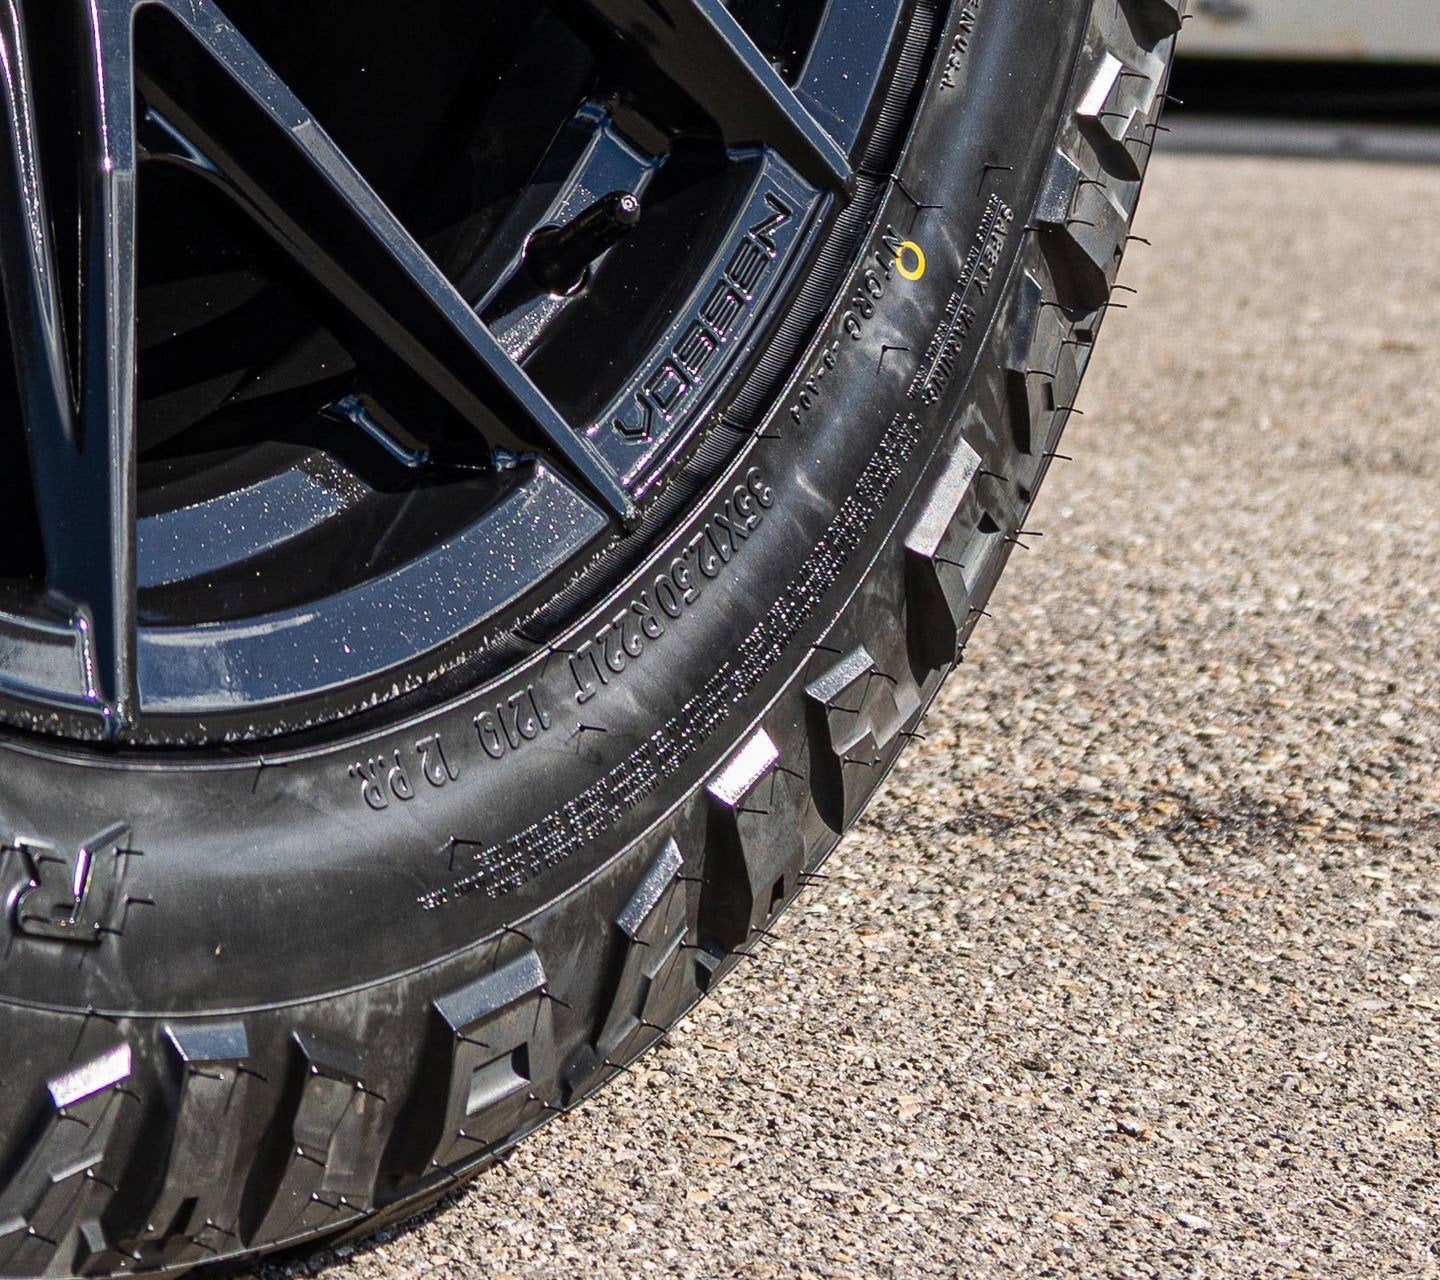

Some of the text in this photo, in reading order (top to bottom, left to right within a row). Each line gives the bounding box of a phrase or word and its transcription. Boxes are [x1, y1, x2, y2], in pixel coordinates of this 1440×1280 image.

[958, 7, 977, 35] IN
[938, 33, 969, 92] U.S.A.
[974, 199, 1015, 297] SAFETY
[611, 190, 794, 446] VOSSEN
[566, 465, 777, 706] 35X12.50R22LT
[415, 732, 460, 788] 12
